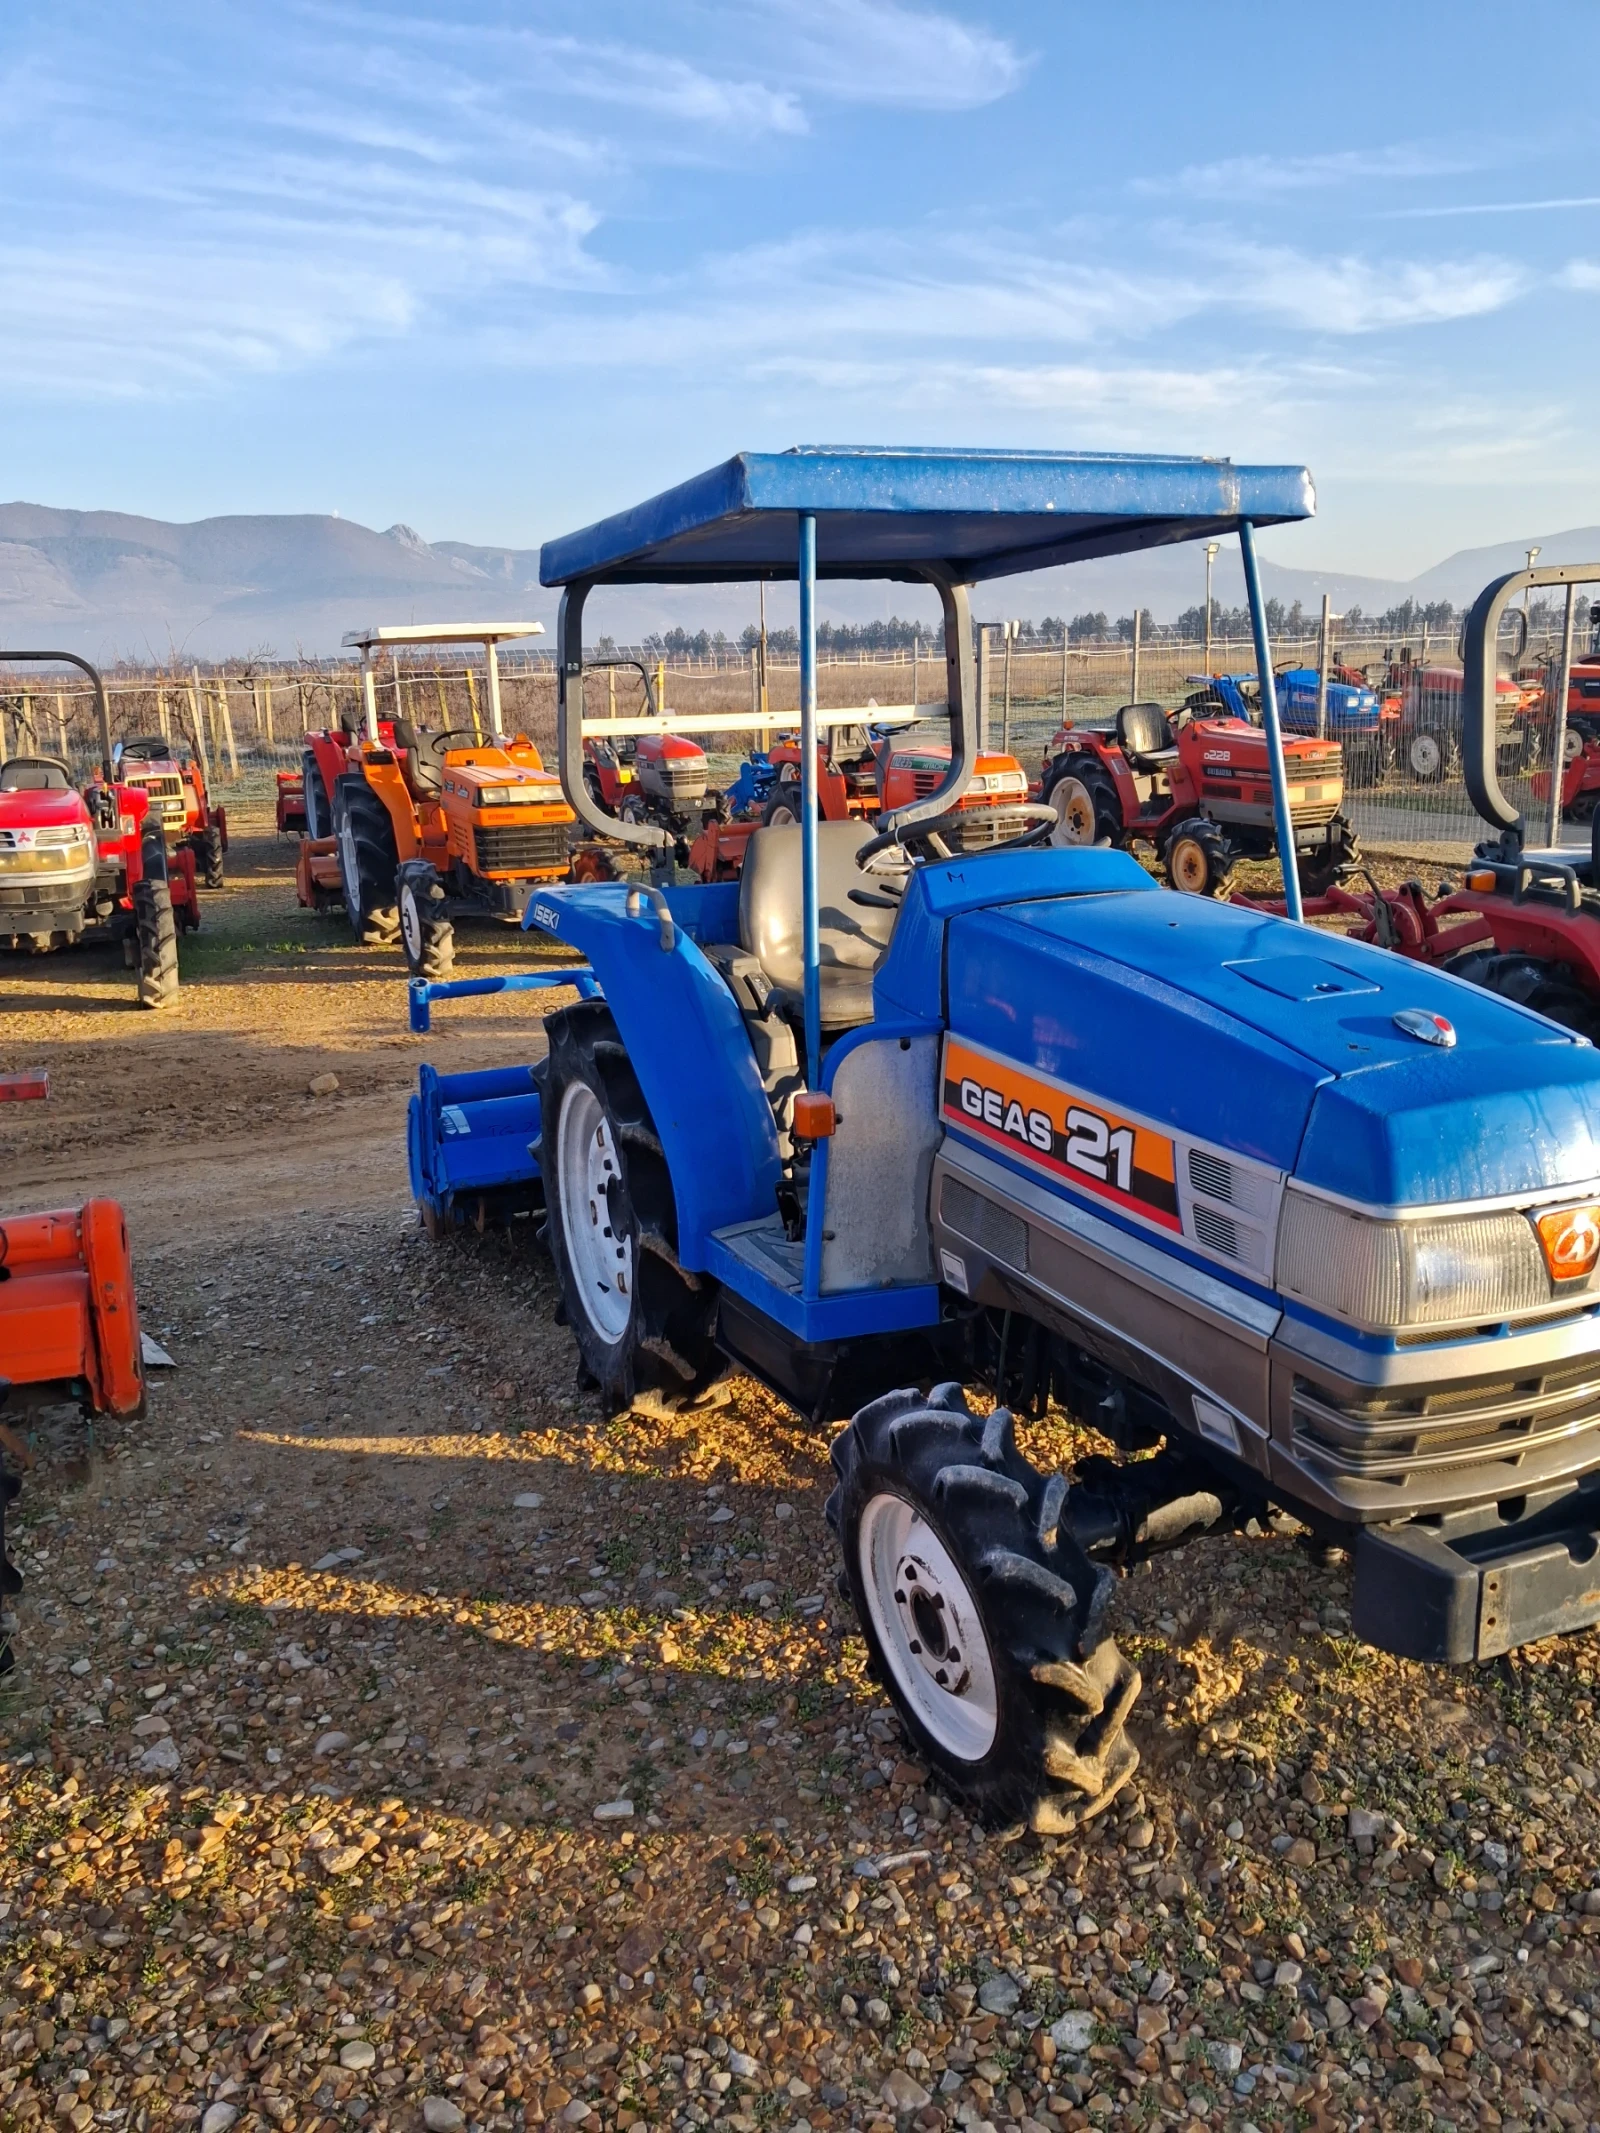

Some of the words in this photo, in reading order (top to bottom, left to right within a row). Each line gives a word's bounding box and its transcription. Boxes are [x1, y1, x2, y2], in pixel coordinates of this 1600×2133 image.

[533, 903, 560, 930] ISEKI
[960, 1078, 1053, 1152] GEAS
[1066, 1107, 1135, 1193] 21
